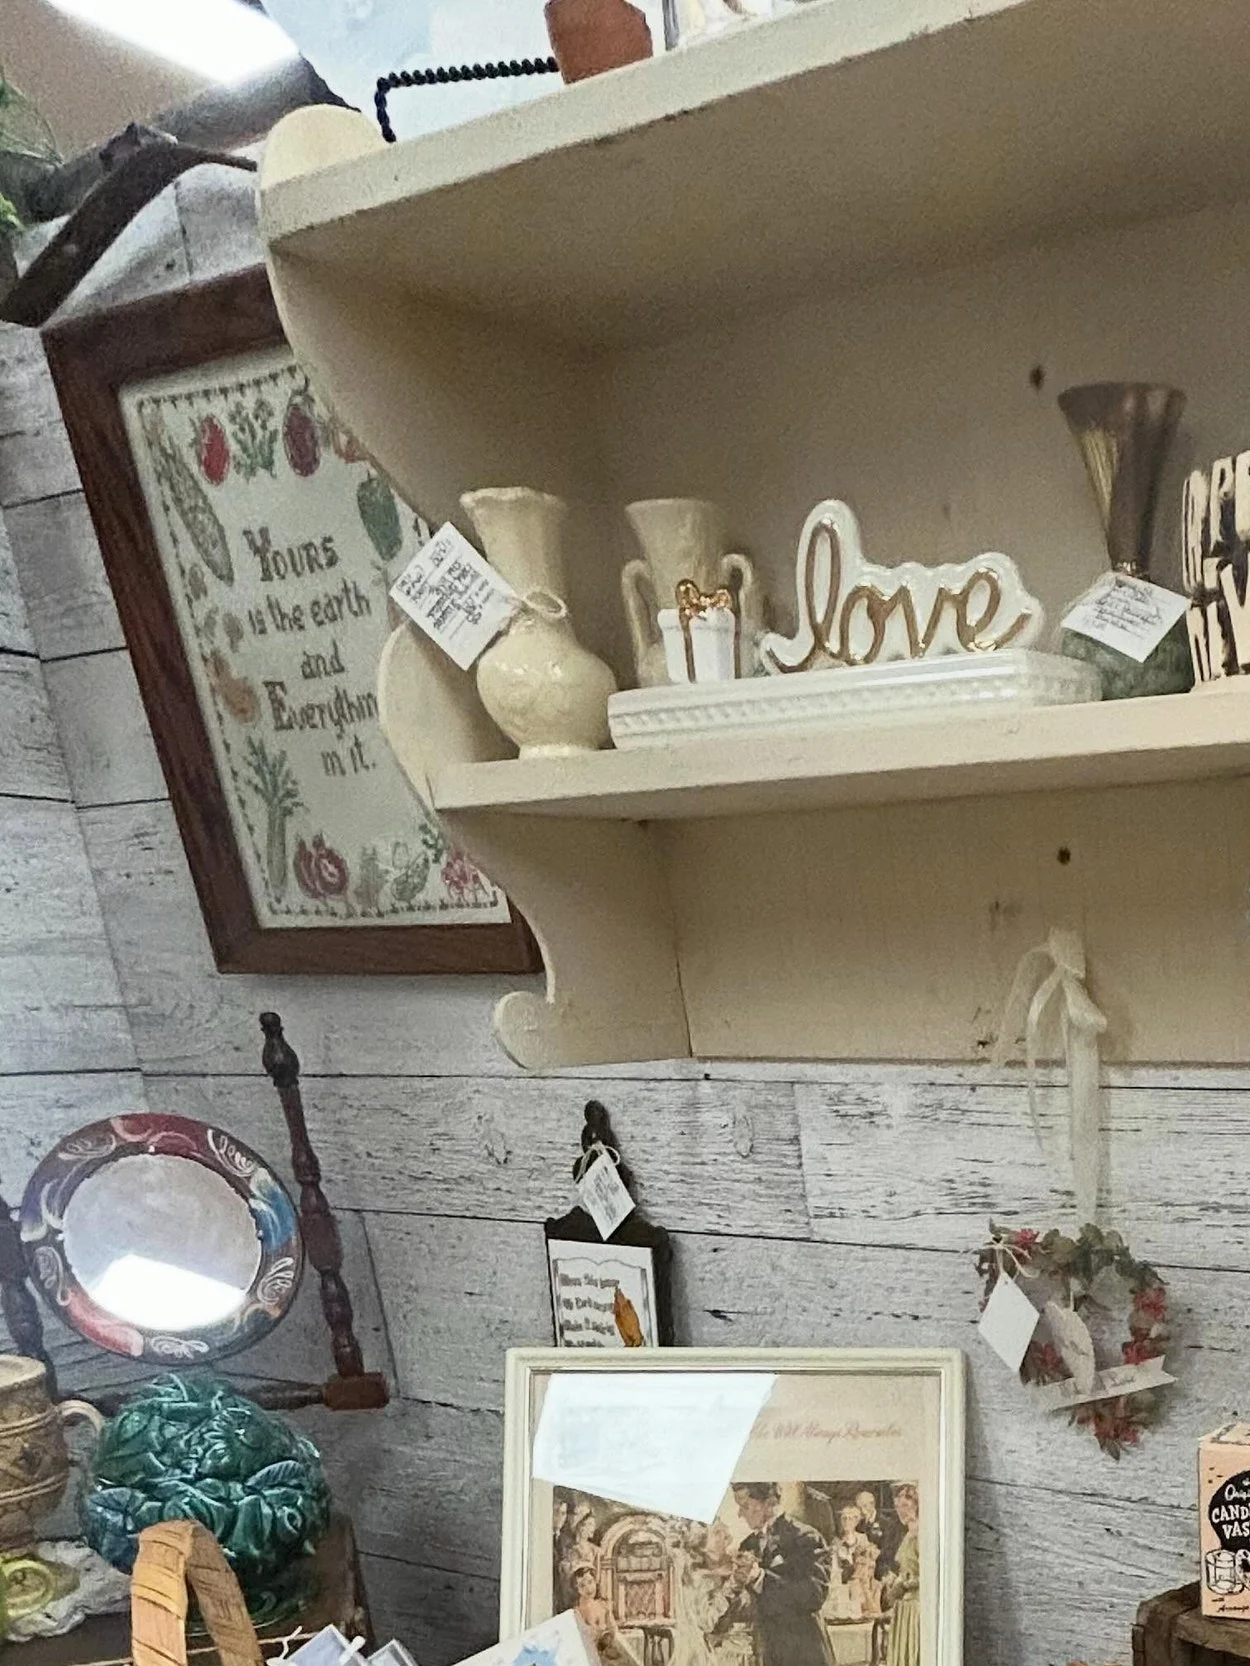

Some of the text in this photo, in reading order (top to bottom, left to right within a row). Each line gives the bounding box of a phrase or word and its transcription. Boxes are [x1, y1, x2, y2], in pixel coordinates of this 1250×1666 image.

[266, 593, 306, 632] the
[310, 577, 373, 627] earth
[764, 512, 1036, 676] love
[301, 639, 345, 680] and
